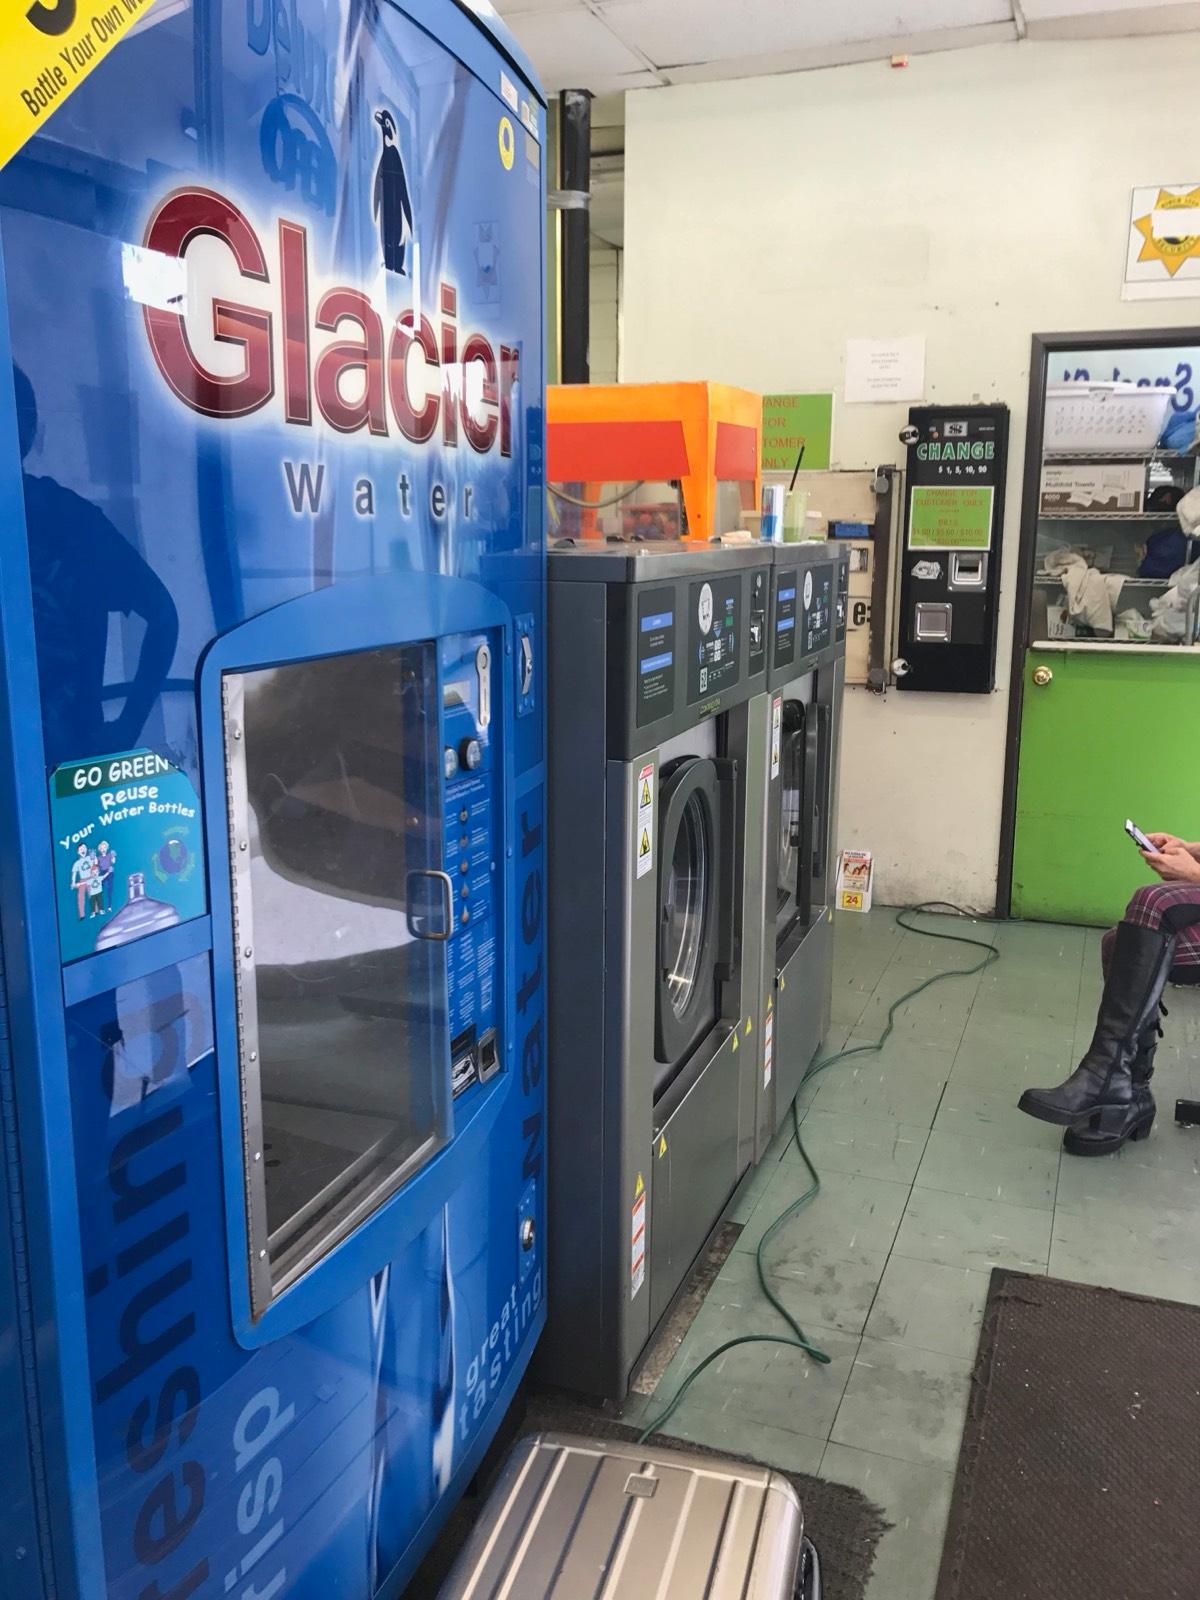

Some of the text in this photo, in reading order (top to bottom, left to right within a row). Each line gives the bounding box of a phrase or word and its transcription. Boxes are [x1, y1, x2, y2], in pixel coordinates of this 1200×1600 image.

[20, 66, 67, 117] Bottle
[59, 33, 97, 74] Your
[91, 5, 125, 43] Own
[142, 185, 519, 458] Glacier
[917, 441, 995, 460] CHANGE
[284, 462, 472, 517] Water
[73, 754, 169, 789] GO GREEN
[100, 785, 159, 810] Reuse
[59, 801, 195, 849] Your Water Bottles
[846, 895, 858, 904] 24
[459, 1267, 542, 1440] tasting
[466, 1282, 517, 1396] great
